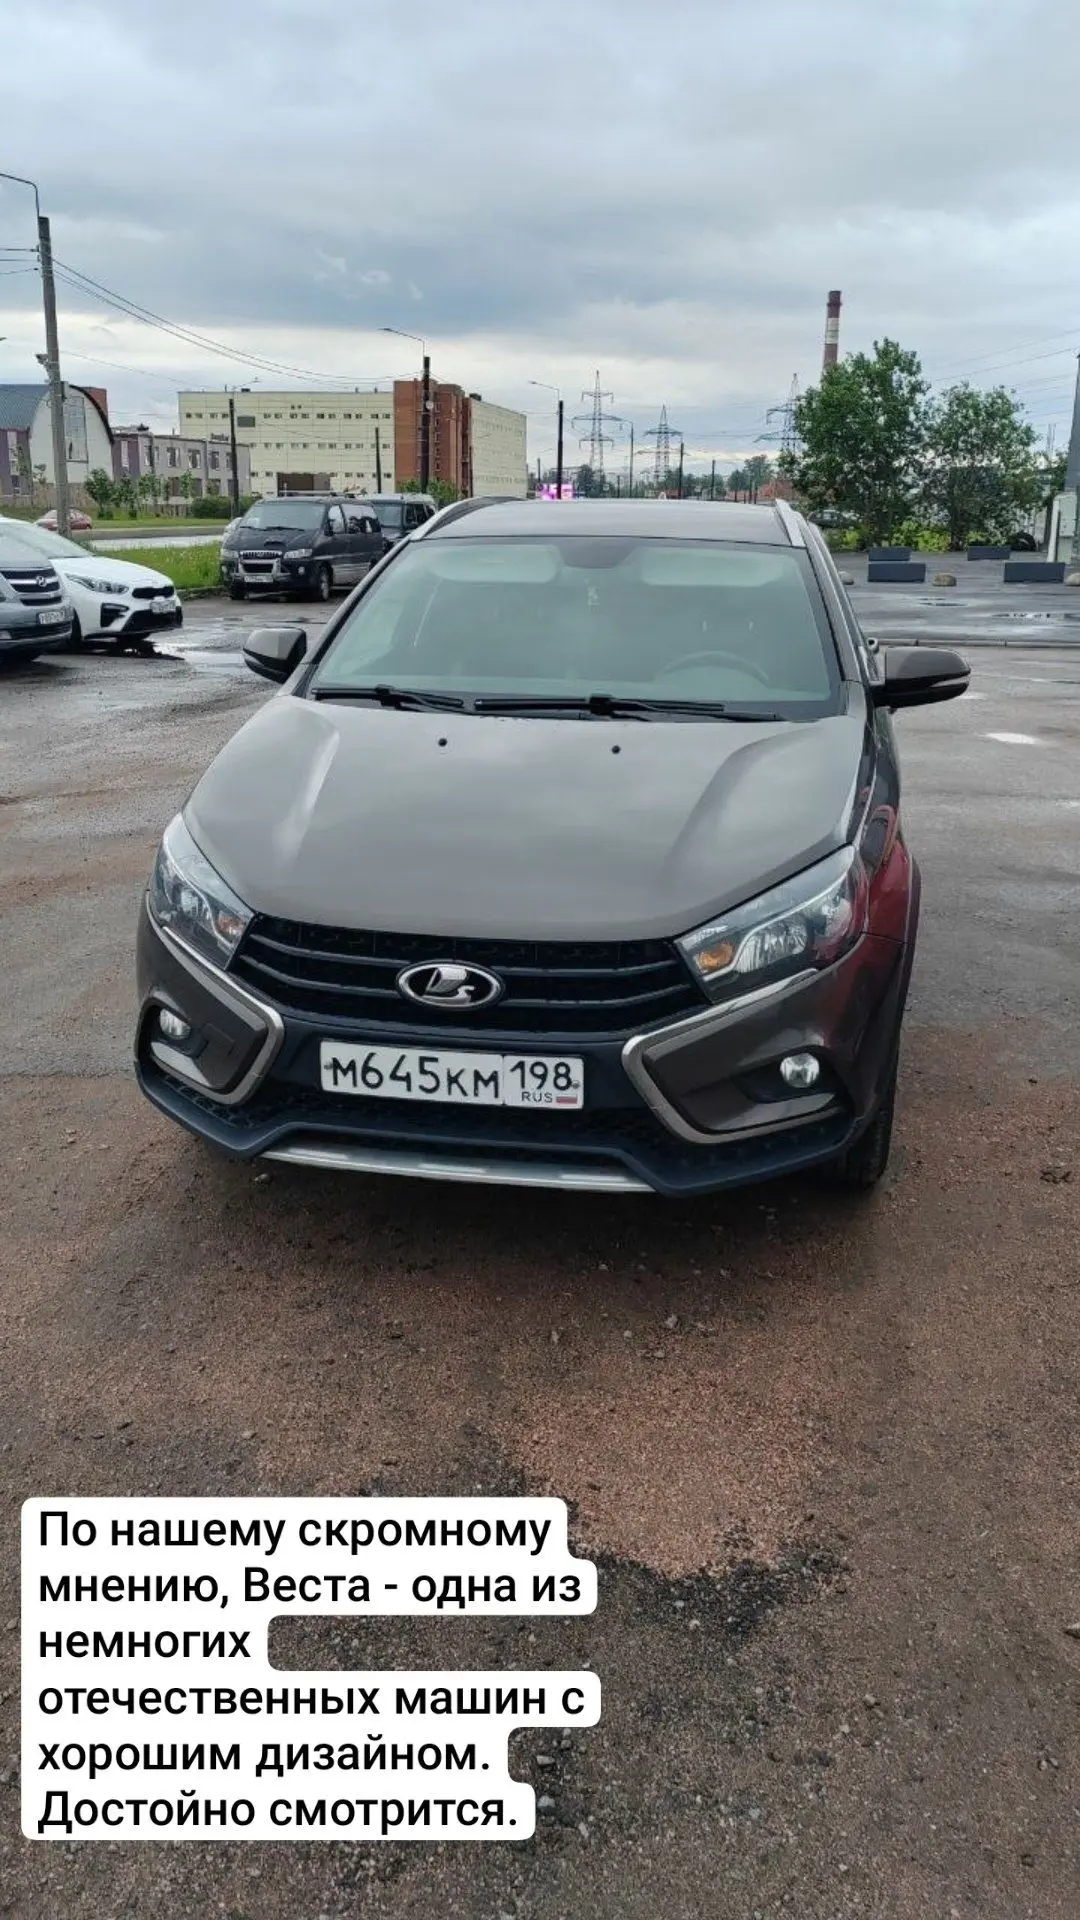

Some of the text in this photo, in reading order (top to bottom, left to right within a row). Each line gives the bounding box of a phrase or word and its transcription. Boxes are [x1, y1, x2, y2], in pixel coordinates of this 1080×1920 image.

[331, 1051, 572, 1099] М645КМ 198
[521, 1091, 553, 1103] RUS
